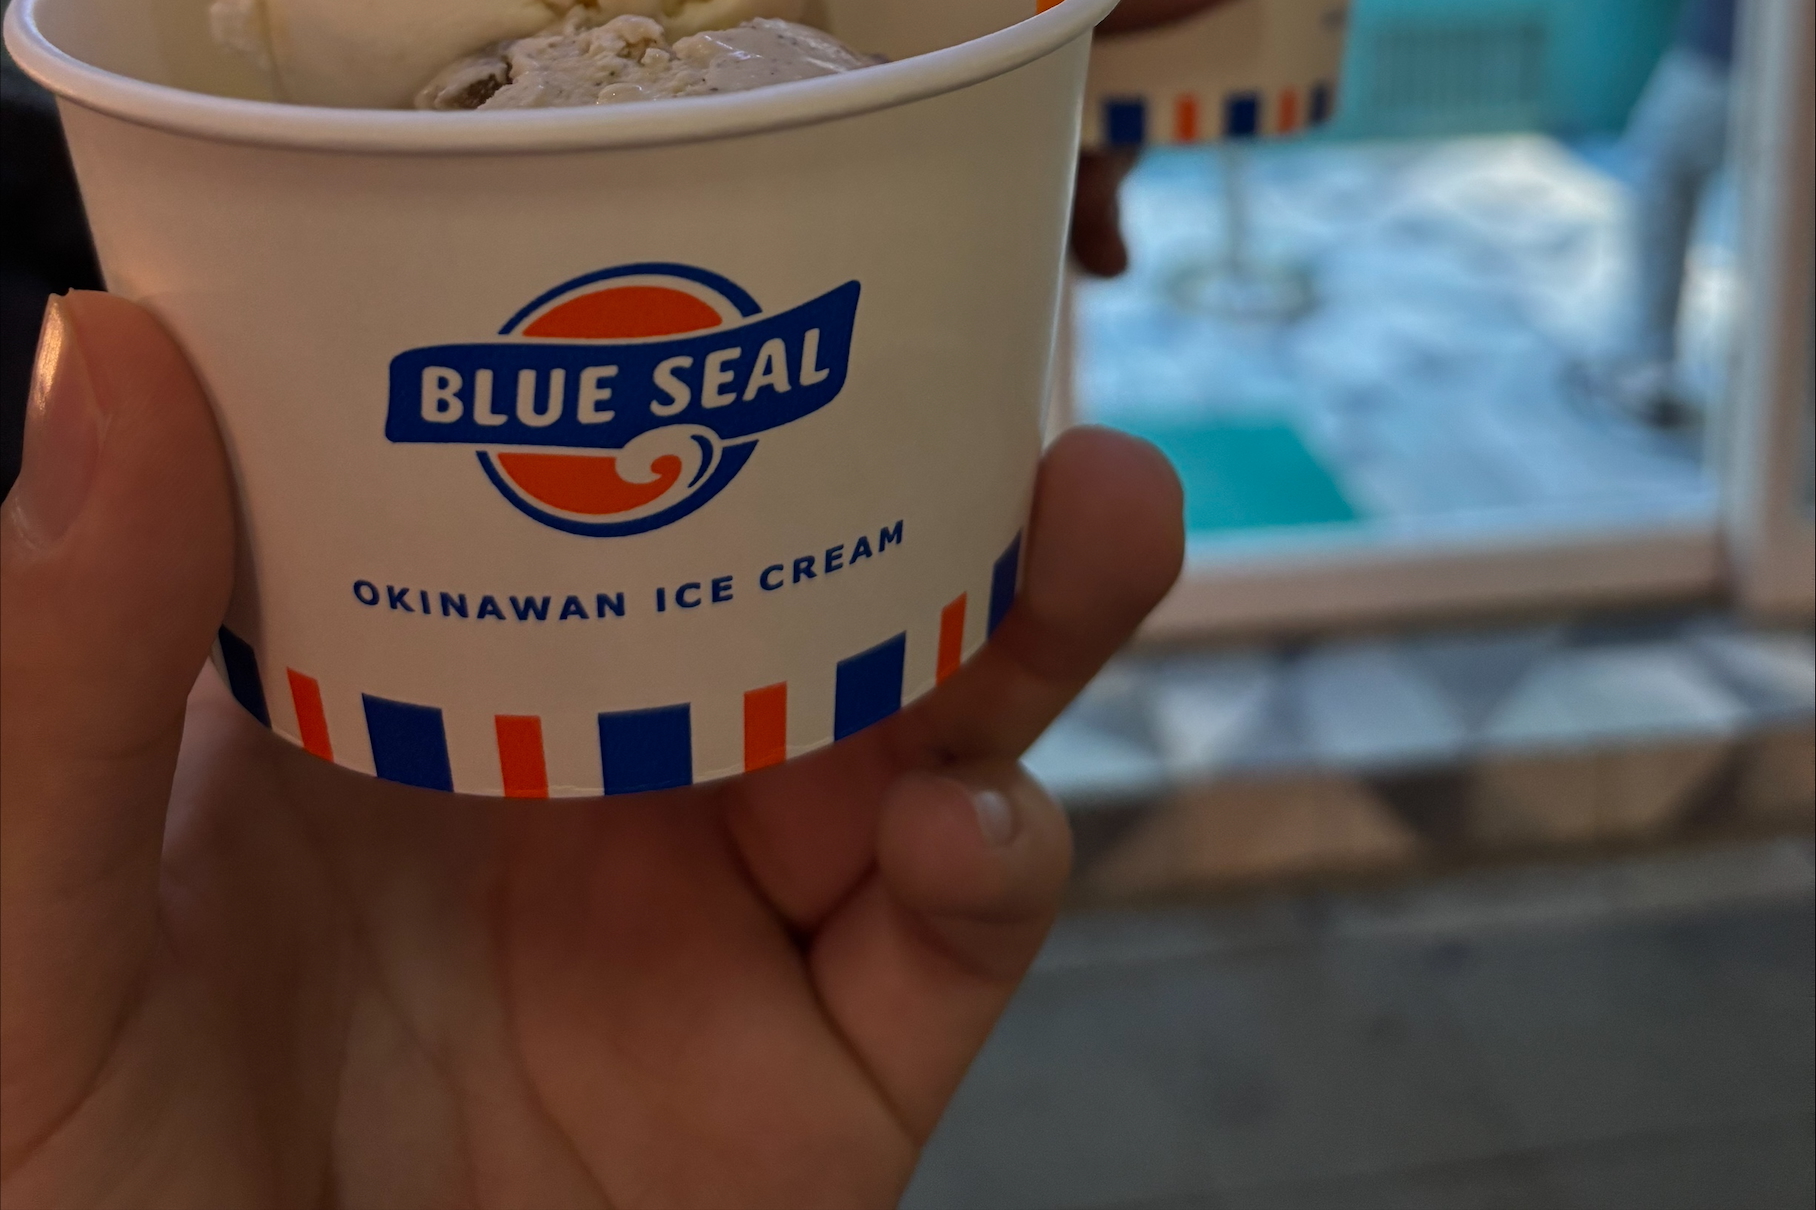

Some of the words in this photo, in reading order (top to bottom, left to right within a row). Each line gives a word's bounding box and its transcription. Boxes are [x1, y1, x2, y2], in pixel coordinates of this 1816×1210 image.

[420, 365, 618, 427] BLUE
[650, 327, 830, 417] SEAL
[353, 579, 625, 621] OKINAWAN
[656, 575, 733, 613] ICE
[759, 519, 904, 591] CREAM
